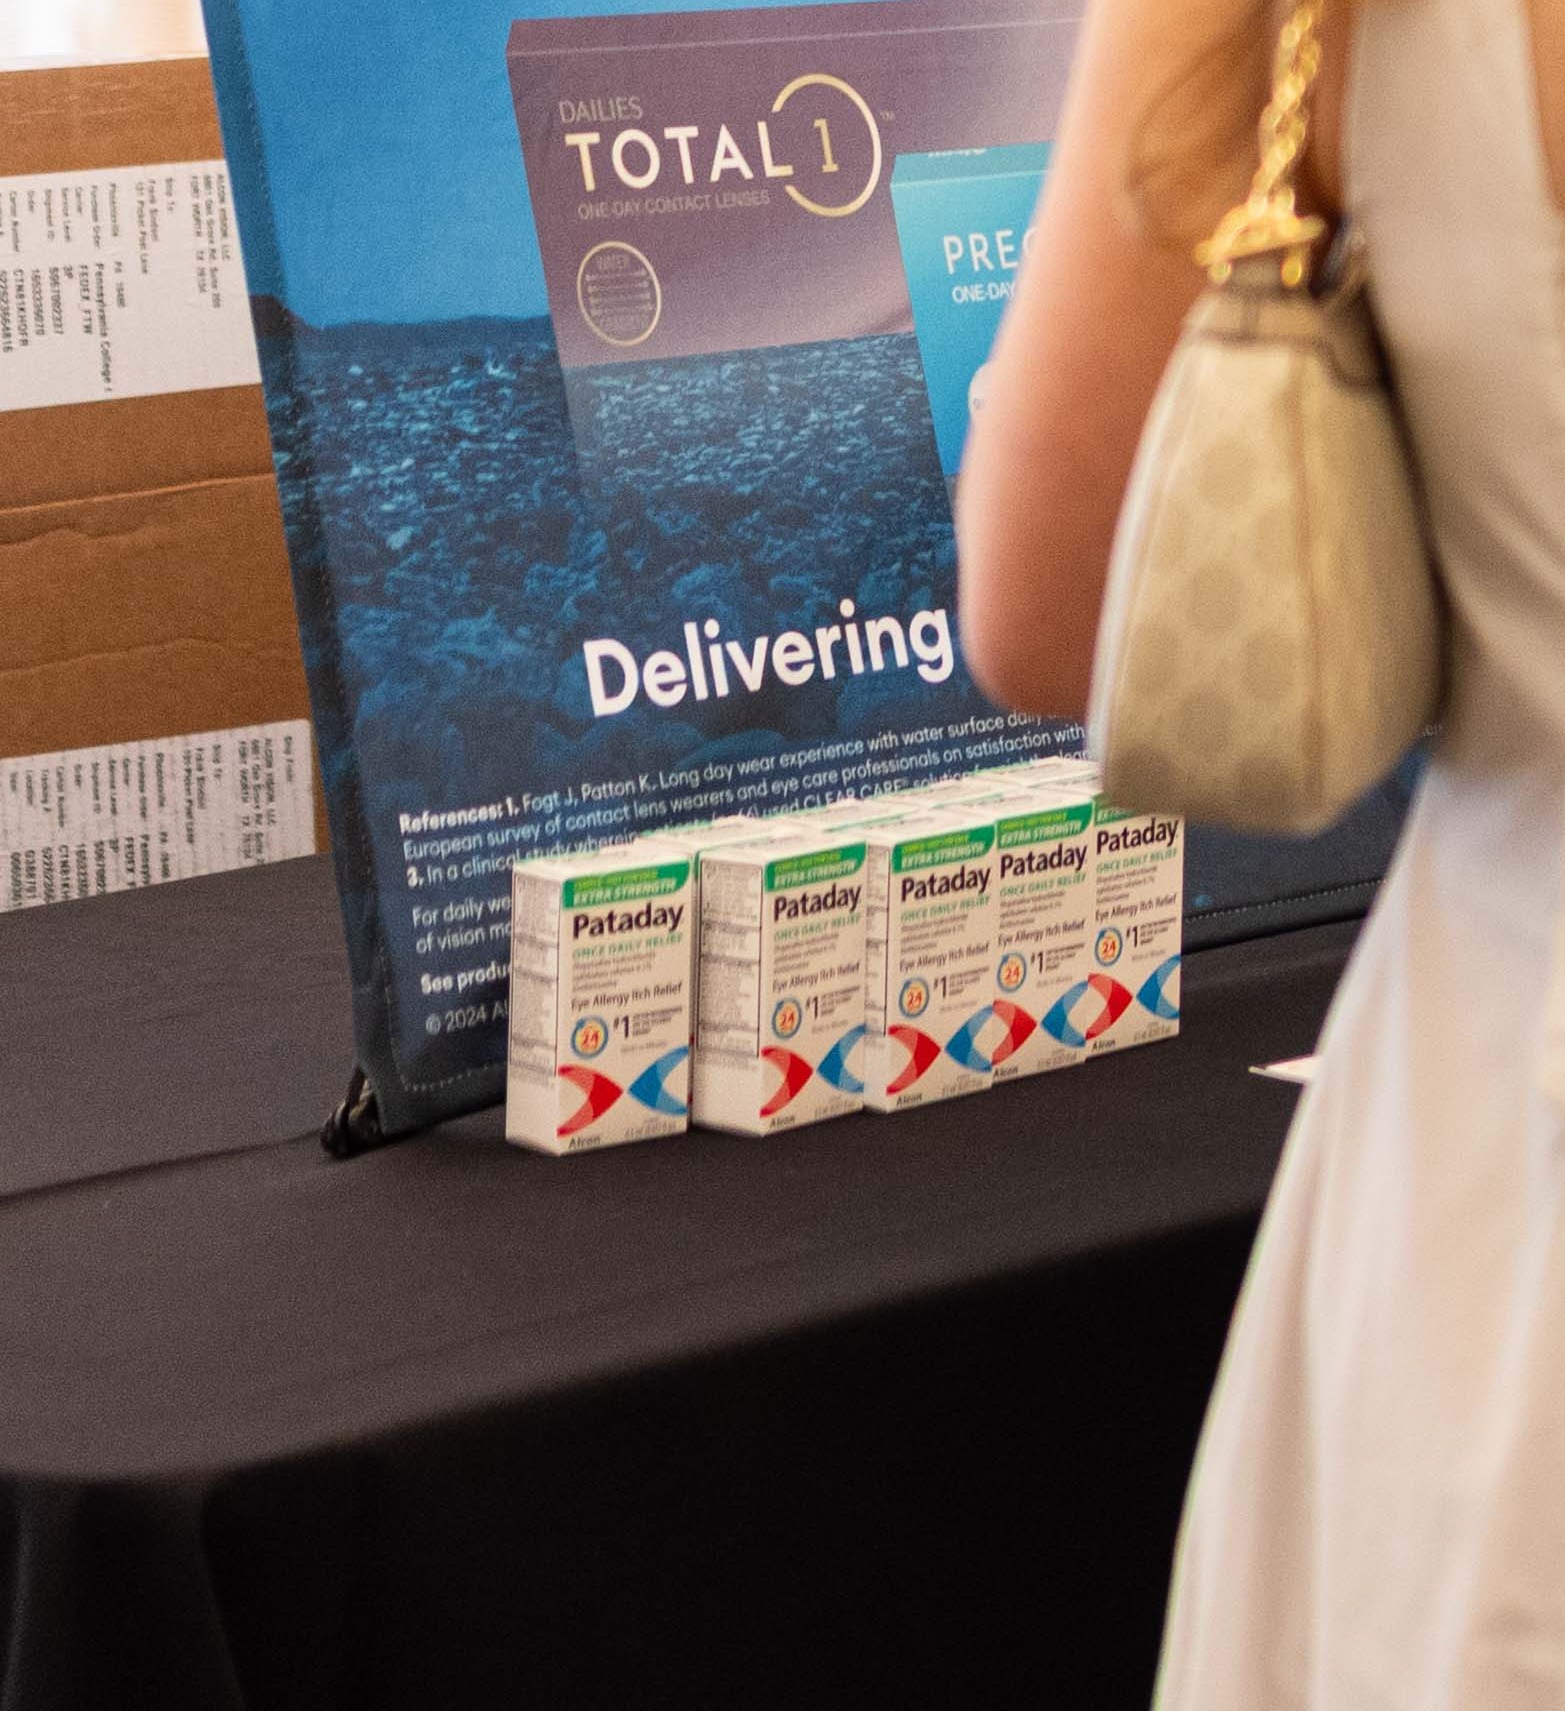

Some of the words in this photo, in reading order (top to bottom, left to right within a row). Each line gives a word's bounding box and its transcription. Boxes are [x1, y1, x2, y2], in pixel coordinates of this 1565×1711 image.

[559, 96, 644, 124] DAILIES
[564, 121, 794, 192] TOTAL
[813, 118, 839, 173] 1
[645, 196, 713, 215] CONTACT
[714, 190, 771, 208] LENSES
[94, 262, 109, 337] Pennsylvania
[100, 341, 113, 385] College
[583, 598, 955, 718] Delivering
[400, 805, 503, 834] References:
[505, 796, 520, 816] 1.
[523, 793, 561, 814] Fogt
[564, 787, 578, 808] J,
[581, 780, 636, 802] Patton
[638, 774, 657, 793] K.
[659, 770, 700, 789] Long
[703, 762, 733, 782] day
[736, 756, 776, 776] wear
[779, 741, 864, 770] experience
[867, 730, 899, 751] with
[901, 726, 945, 746] water
[947, 715, 1005, 739] surface
[403, 833, 484, 862] European
[487, 822, 541, 848] survey
[545, 815, 562, 836] of
[565, 805, 631, 831] contact
[634, 797, 667, 819] lens
[670, 790, 734, 814] wearers
[736, 778, 768, 798] and
[771, 773, 800, 798] eye
[802, 769, 838, 789] care
[841, 748, 941, 787] professionals
[943, 747, 963, 764] on
[965, 730, 1052, 760] satisfaction
[1053, 722, 1087, 744] with
[1096, 817, 1179, 856] Pataday
[406, 865, 425, 889] 3.
[426, 866, 443, 885] In
[447, 866, 459, 881] a
[462, 848, 520, 879] clinical
[1001, 842, 1087, 880] Pataday
[901, 864, 991, 903] Pataday
[411, 904, 439, 928] For
[443, 896, 485, 922] daily
[774, 882, 862, 923] Pataday
[1095, 909, 1110, 923] Eye
[1110, 903, 1138, 918] Allergy
[573, 900, 685, 940] Pataday
[416, 930, 433, 955] of
[437, 926, 486, 952] vision
[1014, 928, 1044, 943] Allergy
[1102, 938, 1116, 954] 24
[916, 954, 947, 970] Allergy
[1006, 965, 1020, 981] 24
[420, 972, 454, 995] See
[789, 973, 819, 989] Allergy
[571, 998, 590, 1012] Eye
[592, 991, 630, 1008] Allergy
[632, 987, 651, 1001] Itch
[653, 981, 683, 998] Relief
[907, 991, 923, 1007] 24
[444, 1004, 488, 1033] 2024
[780, 1011, 795, 1026] 24
[582, 1028, 599, 1046] 24
